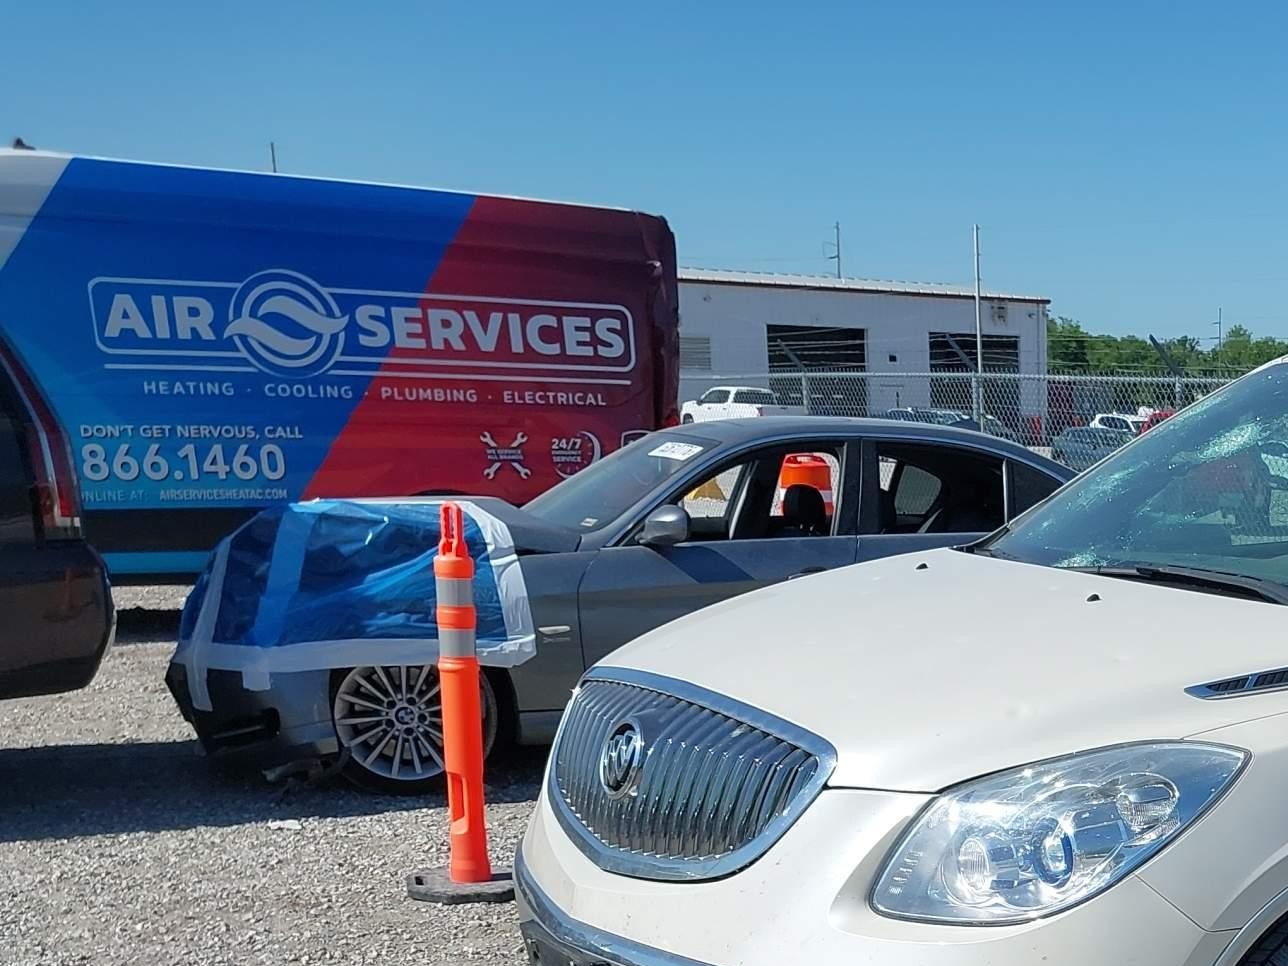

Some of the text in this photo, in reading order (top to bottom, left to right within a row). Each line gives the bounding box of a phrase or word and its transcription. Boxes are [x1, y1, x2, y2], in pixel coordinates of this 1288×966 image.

[104, 293, 625, 358] AIR SERVICES
[143, 380, 607, 406] HEATING COOLING PLUMBING ELECTRICAL
[80, 424, 304, 440] DON'T GET NERVOUS, CALL
[551, 438, 581, 450] 24/7
[81, 443, 286, 481] 866.1460
